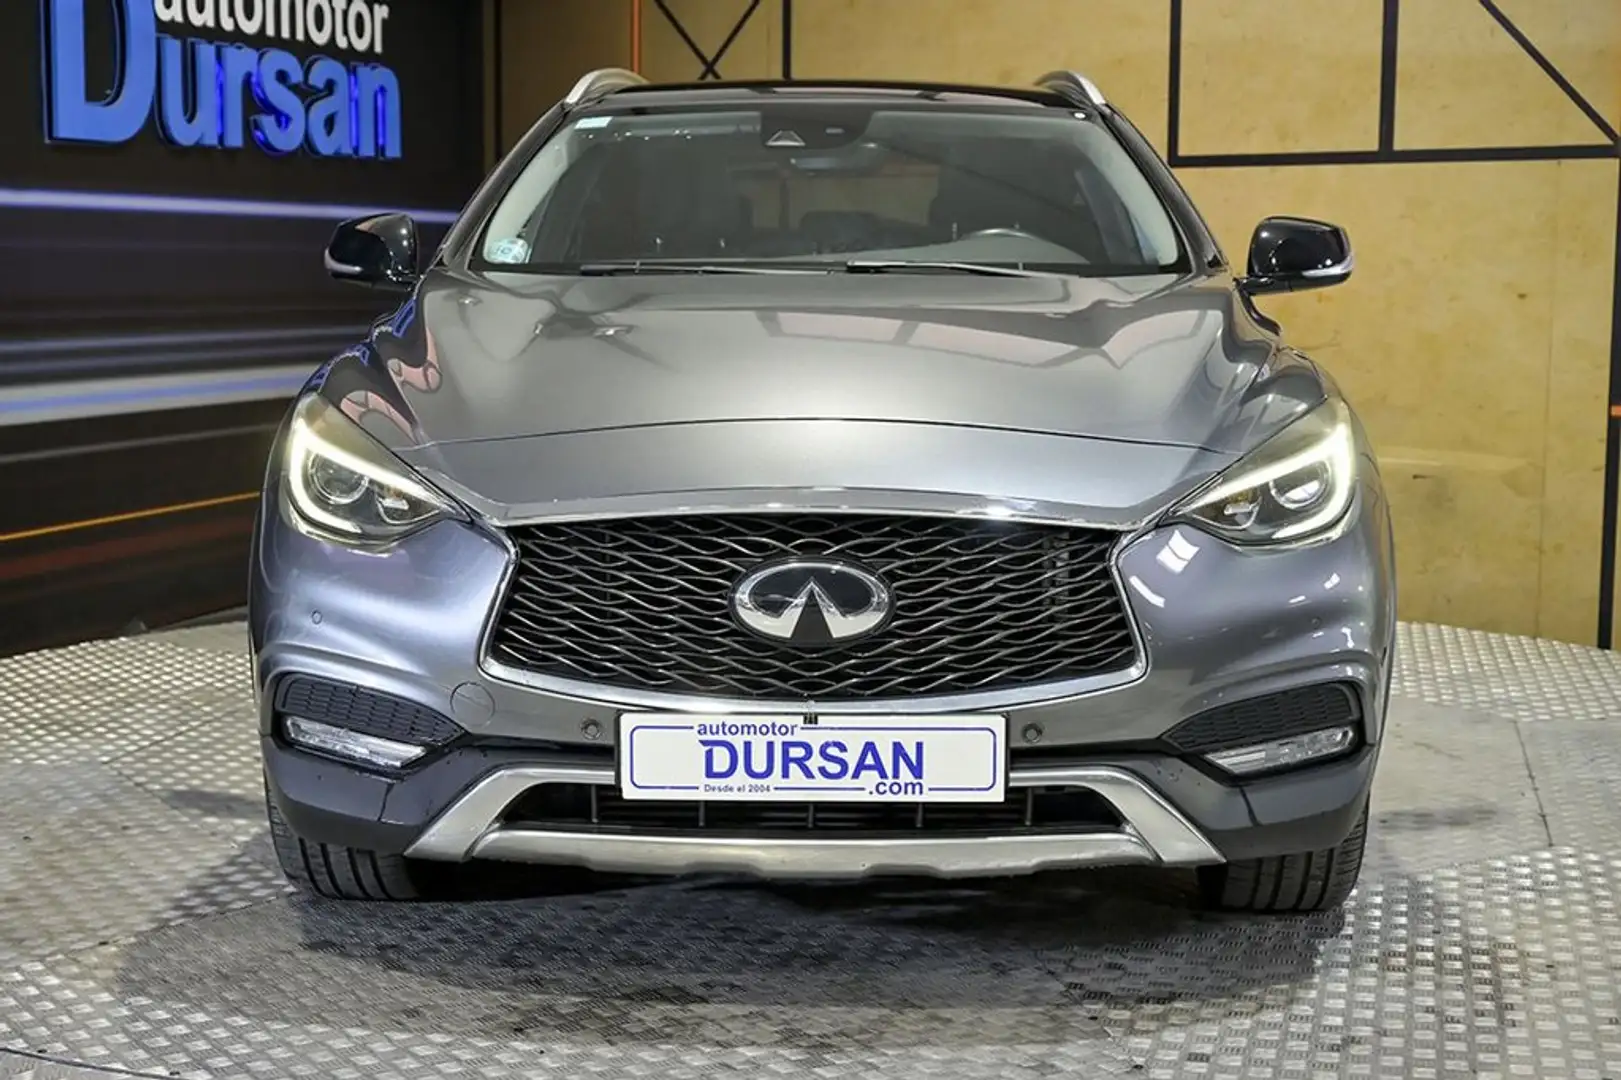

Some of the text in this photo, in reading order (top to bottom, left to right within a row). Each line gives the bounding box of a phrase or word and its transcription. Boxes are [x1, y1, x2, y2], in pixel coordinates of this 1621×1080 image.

[45, 0, 402, 159] Dursan
[697, 721, 798, 736] automotor
[699, 740, 924, 780] DURSAN
[704, 784, 734, 793] Desde
[869, 781, 923, 795] .com
